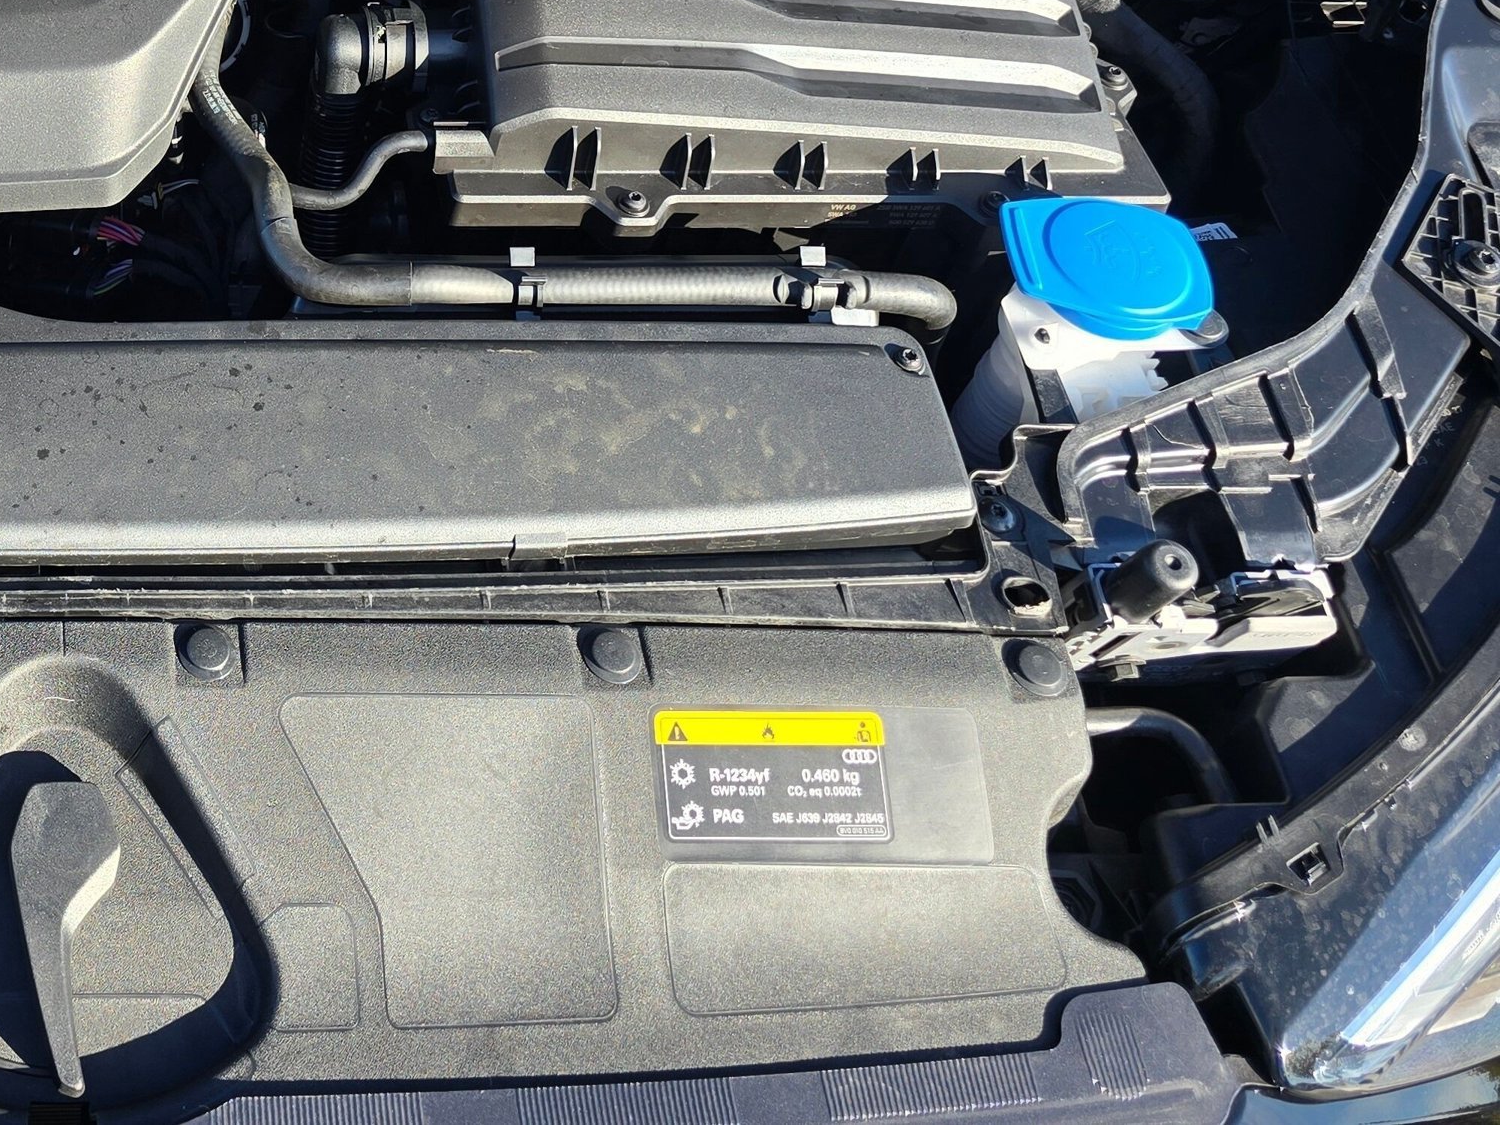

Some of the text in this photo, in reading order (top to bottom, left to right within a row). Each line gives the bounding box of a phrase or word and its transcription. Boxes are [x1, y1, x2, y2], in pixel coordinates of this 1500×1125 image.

[709, 768, 771, 784] R-1234yf
[802, 768, 860, 786] 0.460 kg
[711, 786, 766, 797] GWP 0.501
[809, 788, 822, 799] eq
[825, 785, 862, 797] 0.0002t
[713, 809, 745, 823] PAG
[772, 813, 885, 824] SAE J639 J2842 J2845
